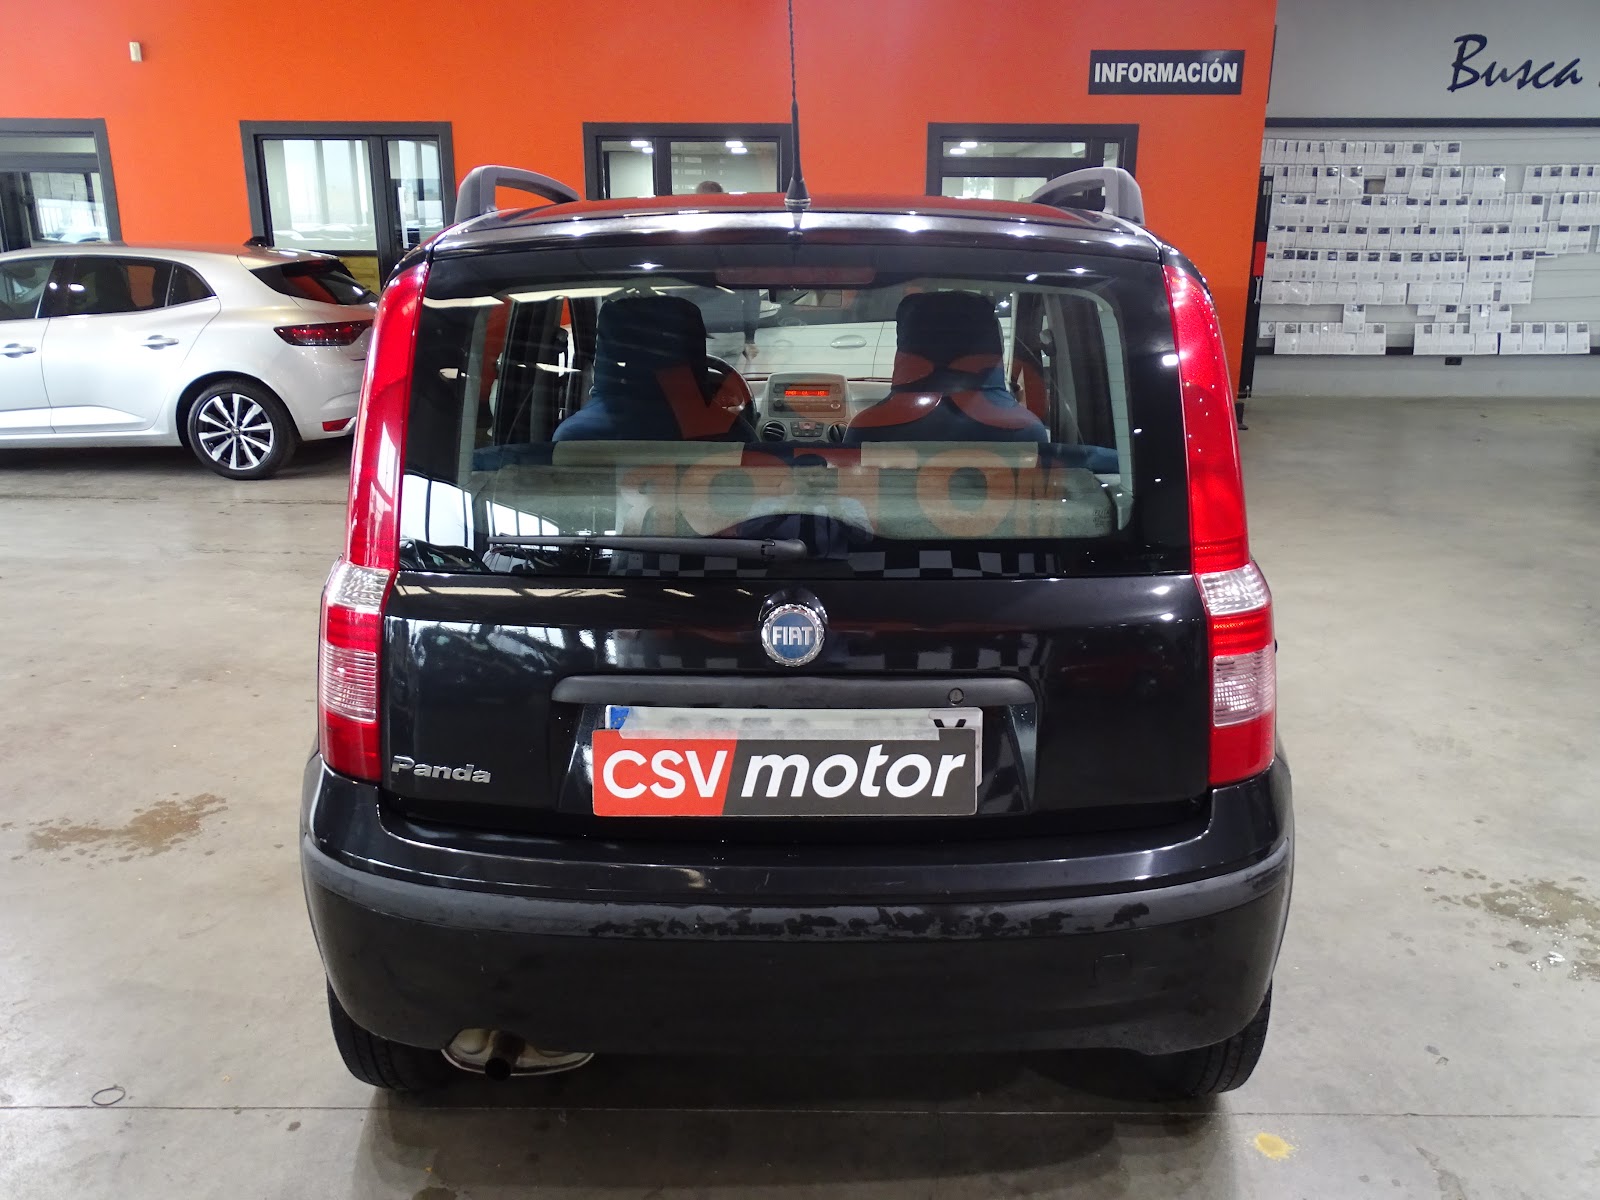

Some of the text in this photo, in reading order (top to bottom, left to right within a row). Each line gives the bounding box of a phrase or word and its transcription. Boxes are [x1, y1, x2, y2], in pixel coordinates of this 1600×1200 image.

[1094, 57, 1238, 83] INFORMACIÓN
[1447, 33, 1583, 93] Busca
[772, 625, 814, 646] FIAT
[391, 755, 492, 784] Panda
[602, 743, 967, 800] CSV motor
